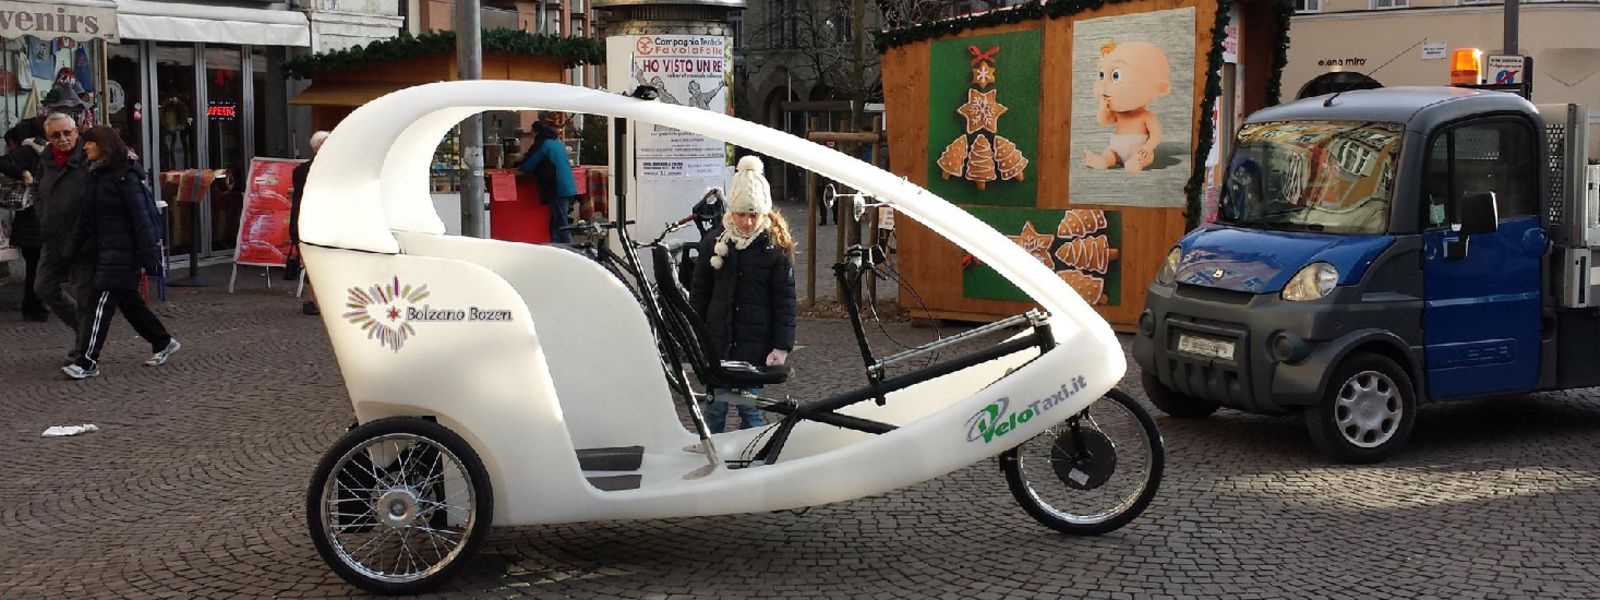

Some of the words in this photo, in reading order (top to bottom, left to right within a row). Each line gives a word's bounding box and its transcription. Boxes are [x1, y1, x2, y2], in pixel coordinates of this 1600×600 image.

[0, 7, 99, 34] venirs
[654, 37, 699, 47] Compagnia
[643, 60, 659, 72] HO
[663, 60, 693, 72] VISTO
[696, 60, 711, 72] UN
[407, 304, 465, 321] Bolzano
[469, 306, 513, 321] Bozen
